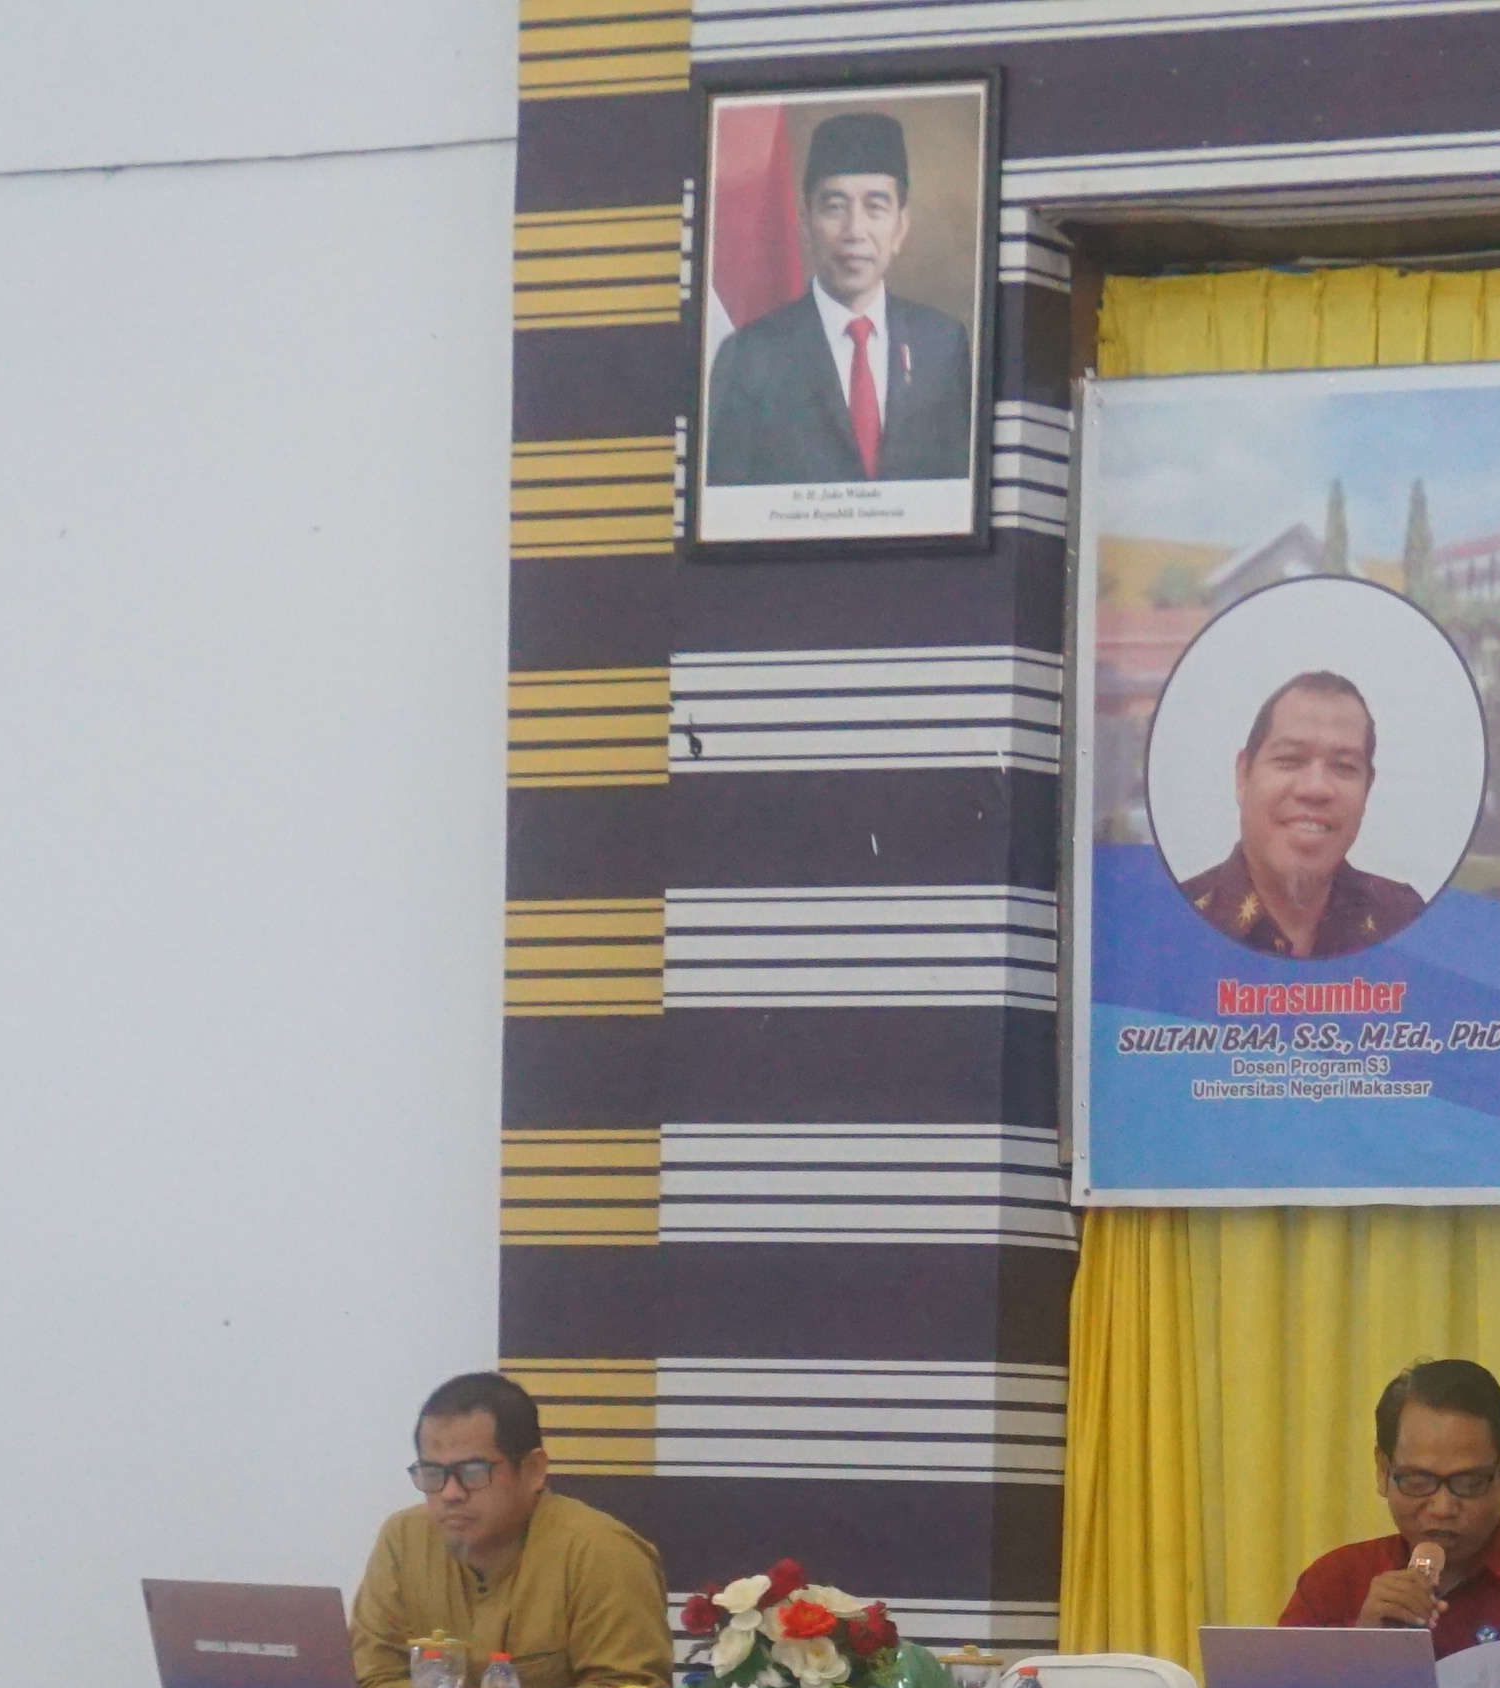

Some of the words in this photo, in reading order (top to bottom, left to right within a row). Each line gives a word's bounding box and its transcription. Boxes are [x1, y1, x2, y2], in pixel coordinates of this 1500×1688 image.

[1217, 976, 1406, 1015] Narasumber
[1118, 1025, 1219, 1054] SULTAN
[1221, 1023, 1286, 1056] BAA,
[1292, 1022, 1352, 1055] S.S.,
[1358, 1021, 1443, 1054] M.Ed.,
[1232, 1058, 1286, 1077] Dosen
[1289, 1058, 1362, 1077] Program
[1365, 1055, 1390, 1075] S3
[1192, 1079, 1286, 1099] Universitas
[1289, 1079, 1344, 1101] Negeri
[1349, 1078, 1432, 1097] Makassar
